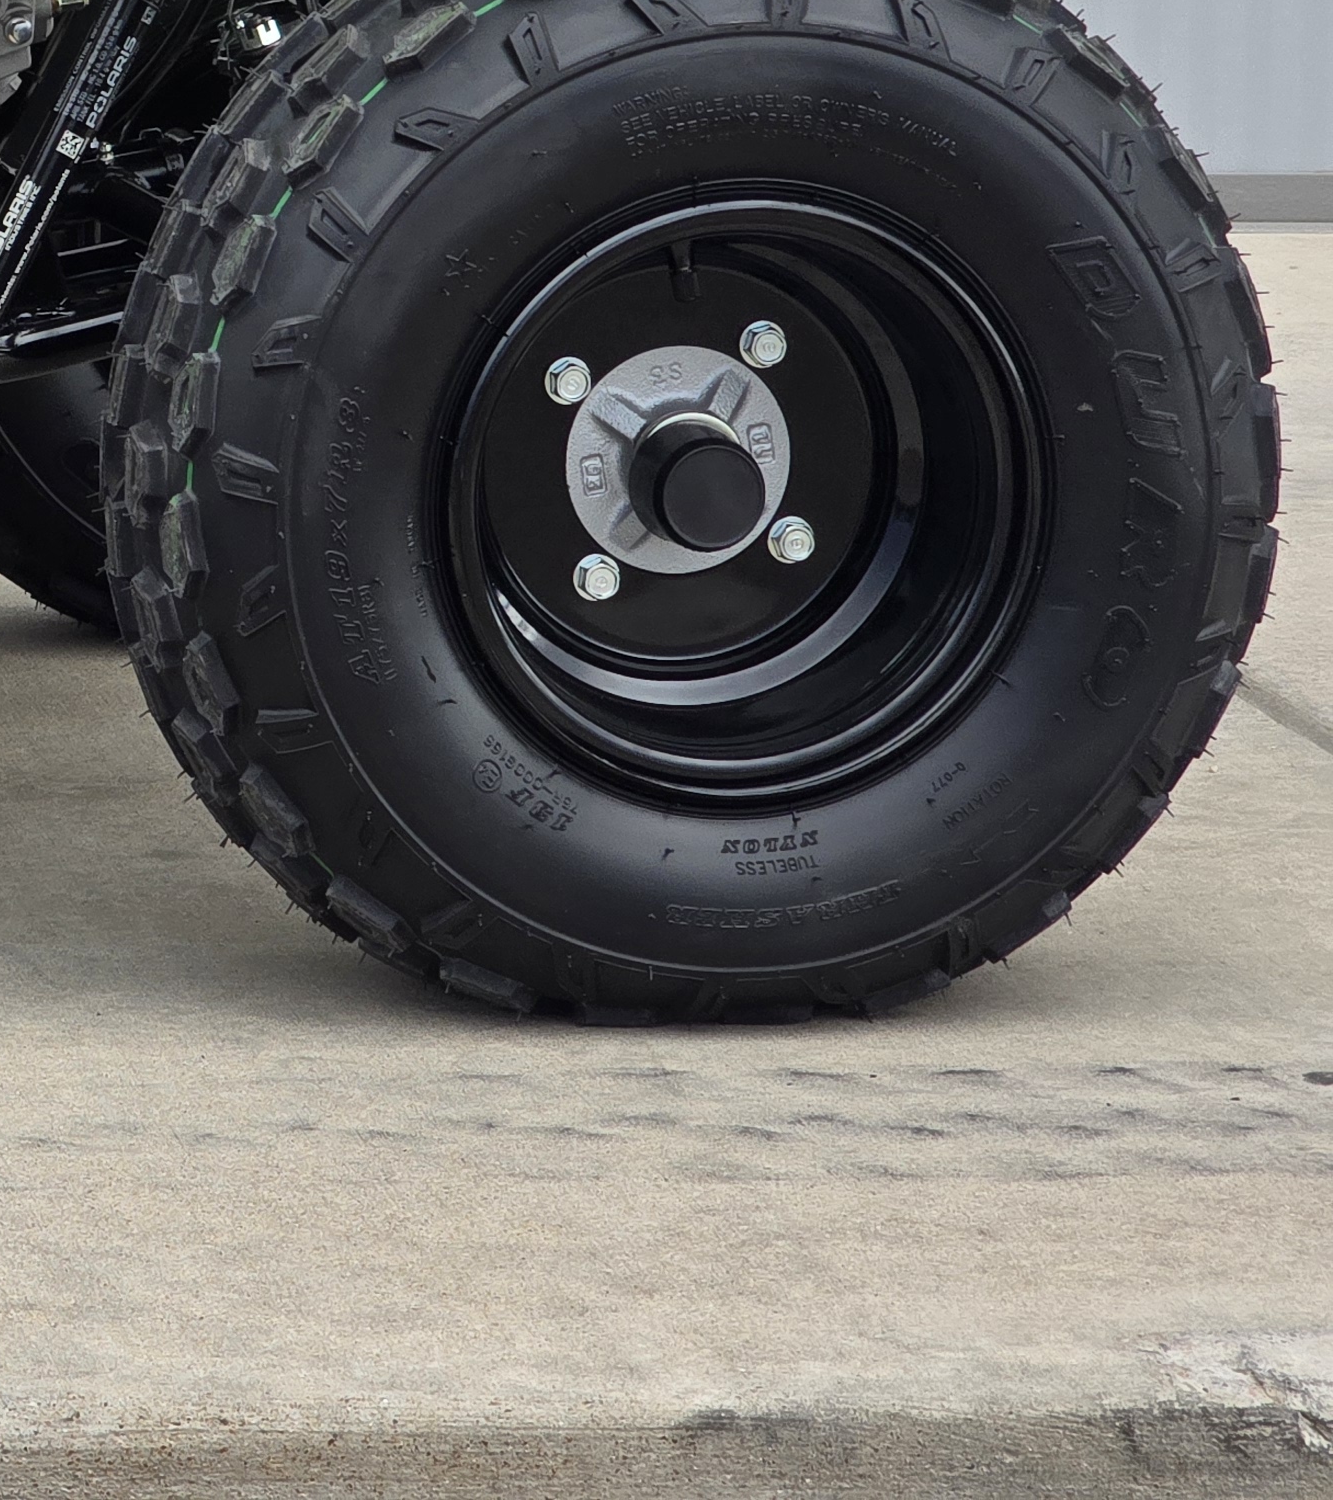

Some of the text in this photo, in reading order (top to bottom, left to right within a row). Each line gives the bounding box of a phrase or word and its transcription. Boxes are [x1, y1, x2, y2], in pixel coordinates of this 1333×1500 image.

[71, 39, 92, 75] CONTROL
[85, 33, 138, 129] POLARIS
[619, 92, 963, 158] SEE VEHICLE LABEL OR OWNER'S MANUAL
[663, 111, 759, 138] OPERATING
[1047, 235, 1186, 710] DURO
[940, 771, 1014, 833] ROTATION
[719, 828, 822, 854] NYLON
[733, 853, 820, 875] TUBELESS
